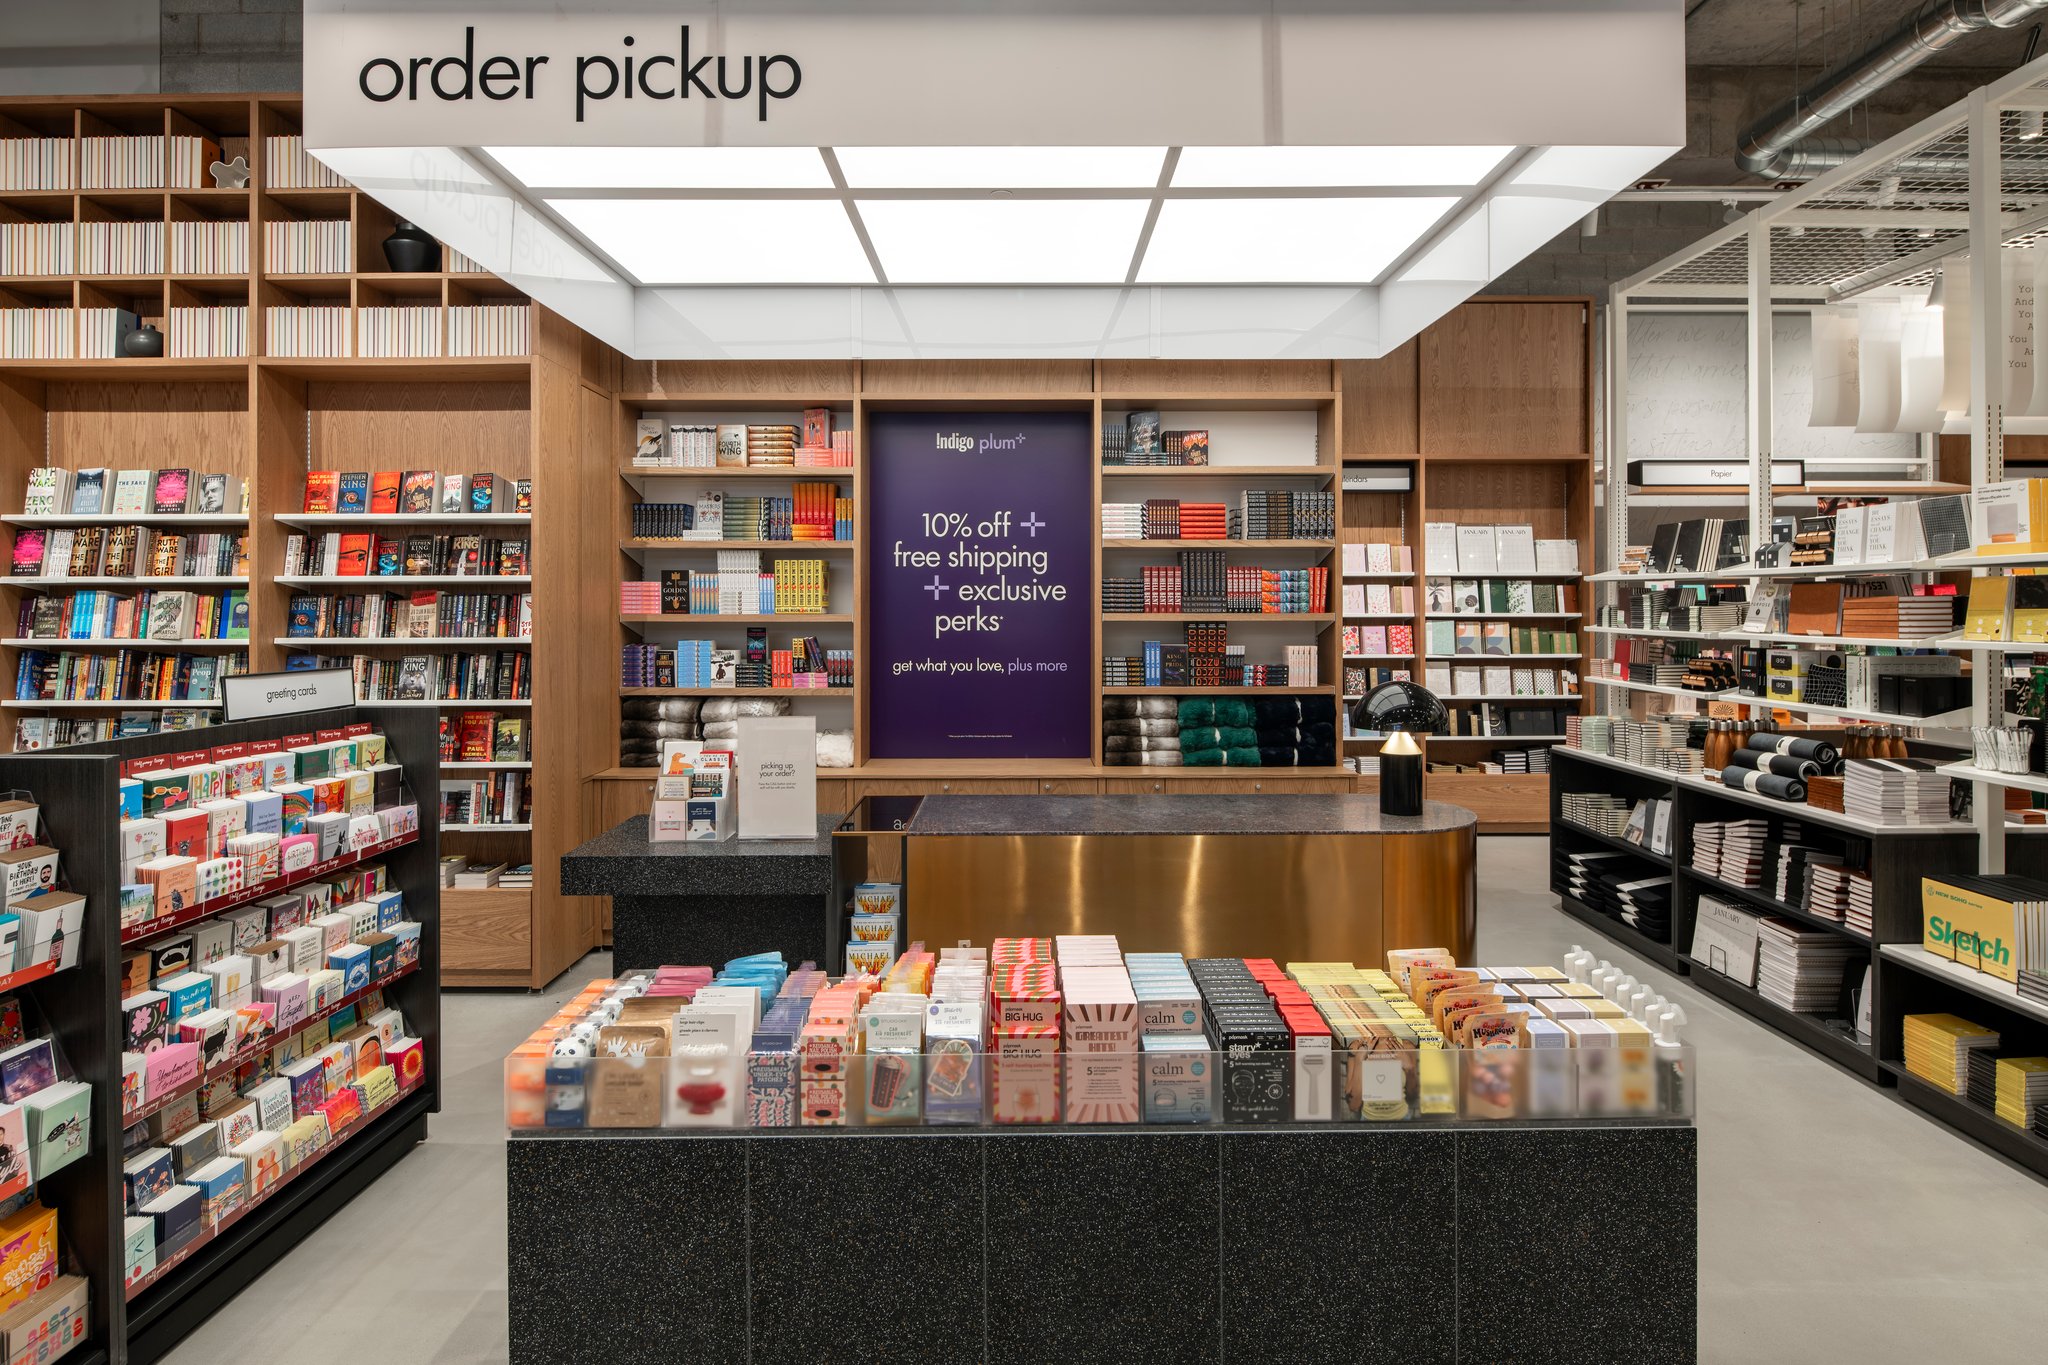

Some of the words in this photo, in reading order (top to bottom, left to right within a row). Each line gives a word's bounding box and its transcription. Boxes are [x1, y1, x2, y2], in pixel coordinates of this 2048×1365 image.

[359, 26, 549, 102] order
[576, 25, 803, 122] pickup
[2008, 335, 2027, 344] You
[2008, 360, 2027, 369] You
[718, 447, 742, 455] WING
[31, 468, 56, 477] RUTH
[1710, 469, 1733, 479] Papier
[28, 478, 56, 487] WARE
[340, 480, 366, 489] KING
[444, 483, 461, 491] KING
[472, 480, 492, 488] KING
[517, 486, 531, 494] KIN
[25, 495, 54, 506] ZERO
[921, 512, 972, 538] 10%
[977, 511, 1012, 538] off
[74, 527, 101, 537] RUTH
[108, 525, 136, 537] RUTH
[73, 537, 99, 547] WARE
[108, 536, 135, 548] WARE
[157, 539, 179, 547] RUTH
[453, 541, 479, 550] KING
[501, 547, 521, 555] KING
[84, 549, 98, 564] IT
[121, 549, 133, 565] IT
[166, 556, 177, 565] IT
[893, 541, 941, 568] free
[948, 541, 1049, 575] shipping
[68, 565, 97, 576] GIRL
[104, 564, 134, 576] GIRL
[154, 567, 174, 576] GIRL
[958, 575, 1067, 601] exclusive
[159, 602, 182, 610] BOOK
[291, 602, 317, 611] KING
[403, 663, 425, 671] KING
[892, 660, 914, 675] get
[915, 658, 947, 672] what
[950, 661, 973, 675] you
[976, 657, 1005, 674] love,
[1007, 658, 1033, 676] plus
[1036, 662, 1068, 672] more
[1349, 671, 1363, 680] 20
[266, 688, 297, 703] greeting
[297, 683, 317, 696] cards
[760, 762, 783, 771] picking
[759, 771, 774, 779] your
[774, 769, 796, 777] order?
[286, 845, 313, 861] BIRTHDAY
[17, 861, 33, 872] YOUR
[293, 856, 308, 868] LOVE
[9, 866, 39, 881] BIRTHDAY
[12, 880, 19, 888] IS
[856, 895, 897, 903] MICHAEL
[1935, 890, 1949, 899] NEW
[1950, 895, 1968, 905] SOHO
[862, 904, 891, 913] LEWIS
[1714, 907, 1741, 924] JANUARY
[131, 920, 159, 934] Halfpenny
[160, 915, 176, 926] Postage
[860, 933, 889, 941] LEWIS
[1928, 915, 2010, 966] Sketch
[848, 952, 892, 960] MICHAEL
[1005, 1012, 1021, 1022] BIG
[1022, 1012, 1043, 1022] HUG
[1144, 1011, 1176, 1024] calm
[1075, 1031, 1129, 1041] GREATEST
[1473, 1026, 1516, 1039] MUSHROOMS
[1088, 1042, 1116, 1052] HITS!
[1229, 1044, 1256, 1054] starry
[1003, 1049, 1019, 1059] BIG
[1021, 1049, 1042, 1059] HUG
[1229, 1051, 1251, 1060] eyes
[1152, 1062, 1184, 1075] calm
[1229, 1060, 1235, 1068] 5
[1087, 1067, 1093, 1076] 5
[132, 1102, 160, 1118] Halfpenny
[161, 1091, 177, 1103] Postage
[144, 1262, 172, 1284] Halfpenny
[172, 1249, 188, 1263] Postage
[28, 1305, 71, 1350] BEST
